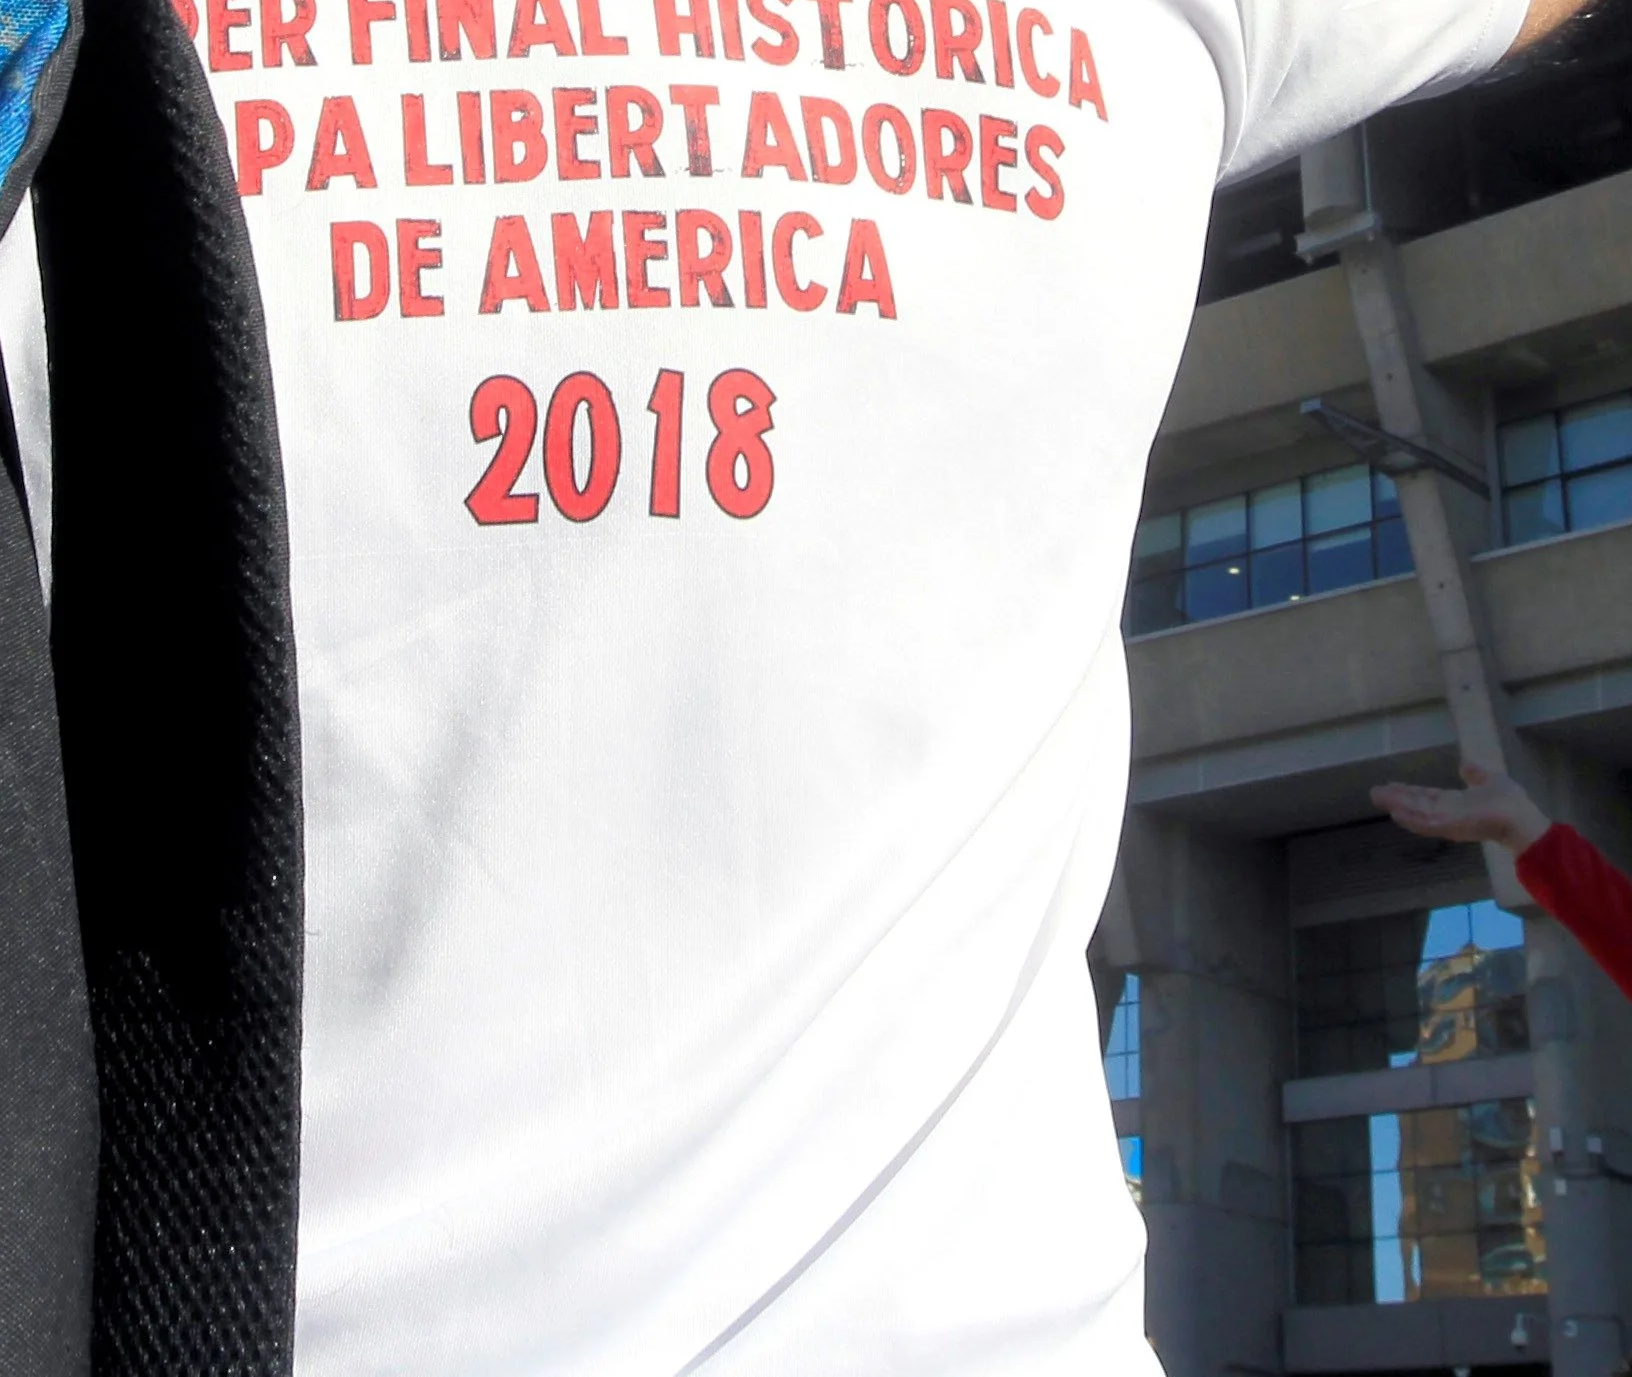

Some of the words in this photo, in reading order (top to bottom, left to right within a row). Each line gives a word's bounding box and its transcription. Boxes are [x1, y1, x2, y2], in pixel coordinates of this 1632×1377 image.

[401, 84, 1066, 221] LIBERTADORES
[330, 218, 446, 322] DE
[478, 208, 898, 321] AMERICA
[464, 367, 778, 526] 2018
